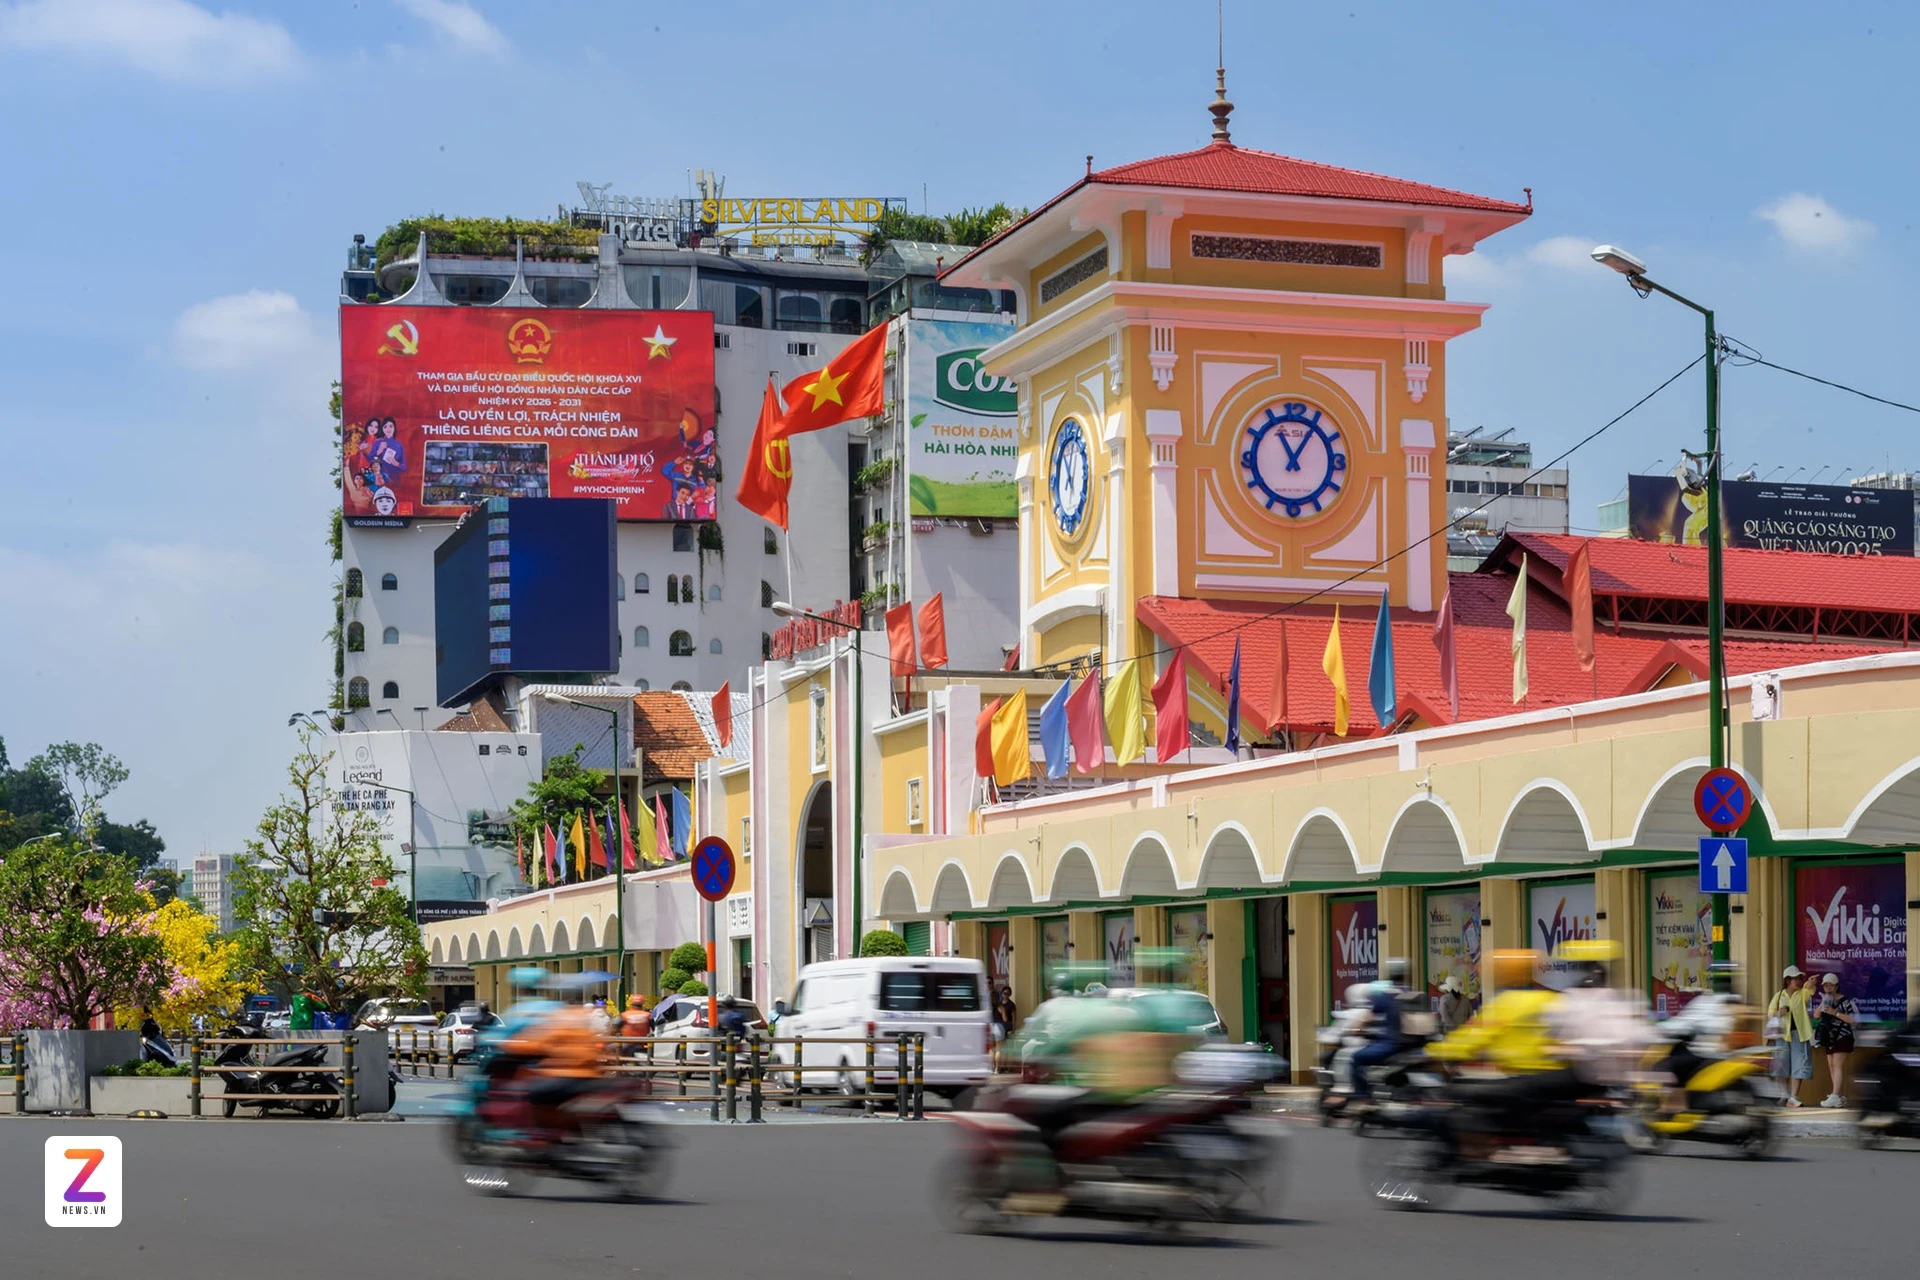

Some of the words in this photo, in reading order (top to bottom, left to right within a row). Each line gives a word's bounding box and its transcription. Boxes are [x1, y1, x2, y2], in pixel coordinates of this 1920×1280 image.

[701, 198, 883, 224] SILVERLAND
[609, 216, 676, 242] hotel
[417, 372, 445, 380] THAM
[447, 372, 464, 380] GIA
[626, 375, 642, 383] XVI
[428, 383, 441, 392] VÀ
[537, 384, 565, 394] NHÂN
[567, 385, 588, 395] DÂN
[590, 385, 610, 395] CÁC
[478, 396, 509, 407] NHIỆM
[526, 398, 551, 406] 2026
[559, 398, 582, 407] 2031
[439, 408, 456, 420] LÀ
[507, 410, 530, 423] LỢI,
[533, 410, 577, 422] TRÁCH
[579, 410, 621, 424] NHIỆM
[1283, 402, 1307, 420] 12
[421, 423, 470, 435] THIÊNG
[473, 424, 511, 437] LIÊNG
[514, 424, 541, 437] CỦA
[543, 423, 567, 437] MỖI
[570, 425, 607, 438] CÔNG
[610, 426, 639, 438] DÂN
[932, 424, 975, 438] THƠM
[978, 424, 1013, 442] ĐẬM
[925, 440, 950, 454] HÀI
[954, 441, 986, 456] HÒA
[990, 445, 1018, 459] NHỊ
[1241, 451, 1253, 469] 9
[1333, 453, 1346, 471] 3
[573, 486, 645, 494] #MYHOCHIMINH
[1286, 500, 1301, 517] 6
[1743, 518, 1795, 538] QUẢNG
[1796, 519, 1826, 536] CÁO
[1828, 521, 1866, 538] SÁNG
[1867, 525, 1896, 541] TẠO
[343, 768, 383, 785] Legend
[1806, 885, 1879, 945] Vikki
[1335, 911, 1377, 965] Vikki
[1806, 950, 1826, 959] Ngân
[1827, 949, 1845, 960] hàng
[1847, 947, 1862, 958] Tiết
[1863, 948, 1882, 960] kiệm
[1883, 947, 1896, 958] Tốt
